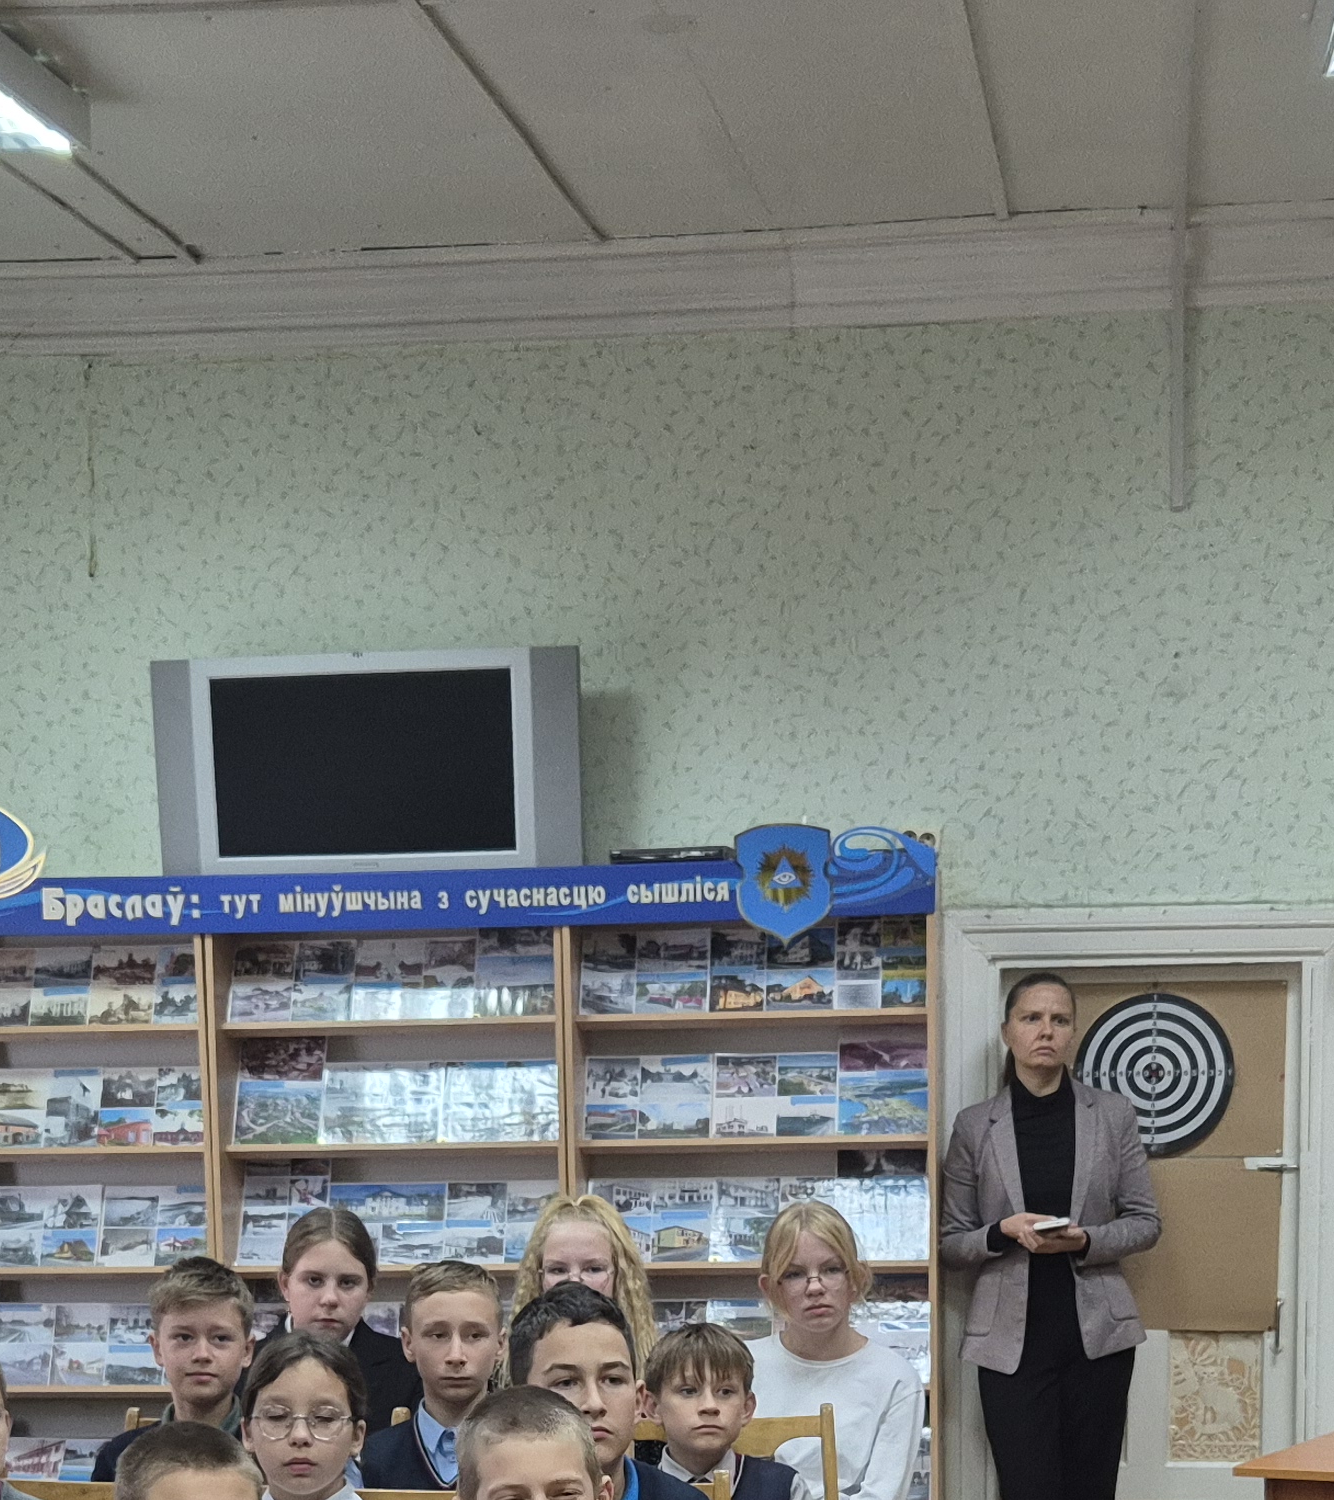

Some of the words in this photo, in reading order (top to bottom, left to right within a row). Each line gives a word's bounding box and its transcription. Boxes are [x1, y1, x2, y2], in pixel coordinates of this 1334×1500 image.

[41, 886, 202, 926] Браслаў:
[220, 894, 262, 919] тут
[278, 884, 423, 918] мінуўшчына
[437, 891, 449, 910] з
[464, 885, 607, 915] сучаснасцю
[626, 876, 730, 907] сышліся
